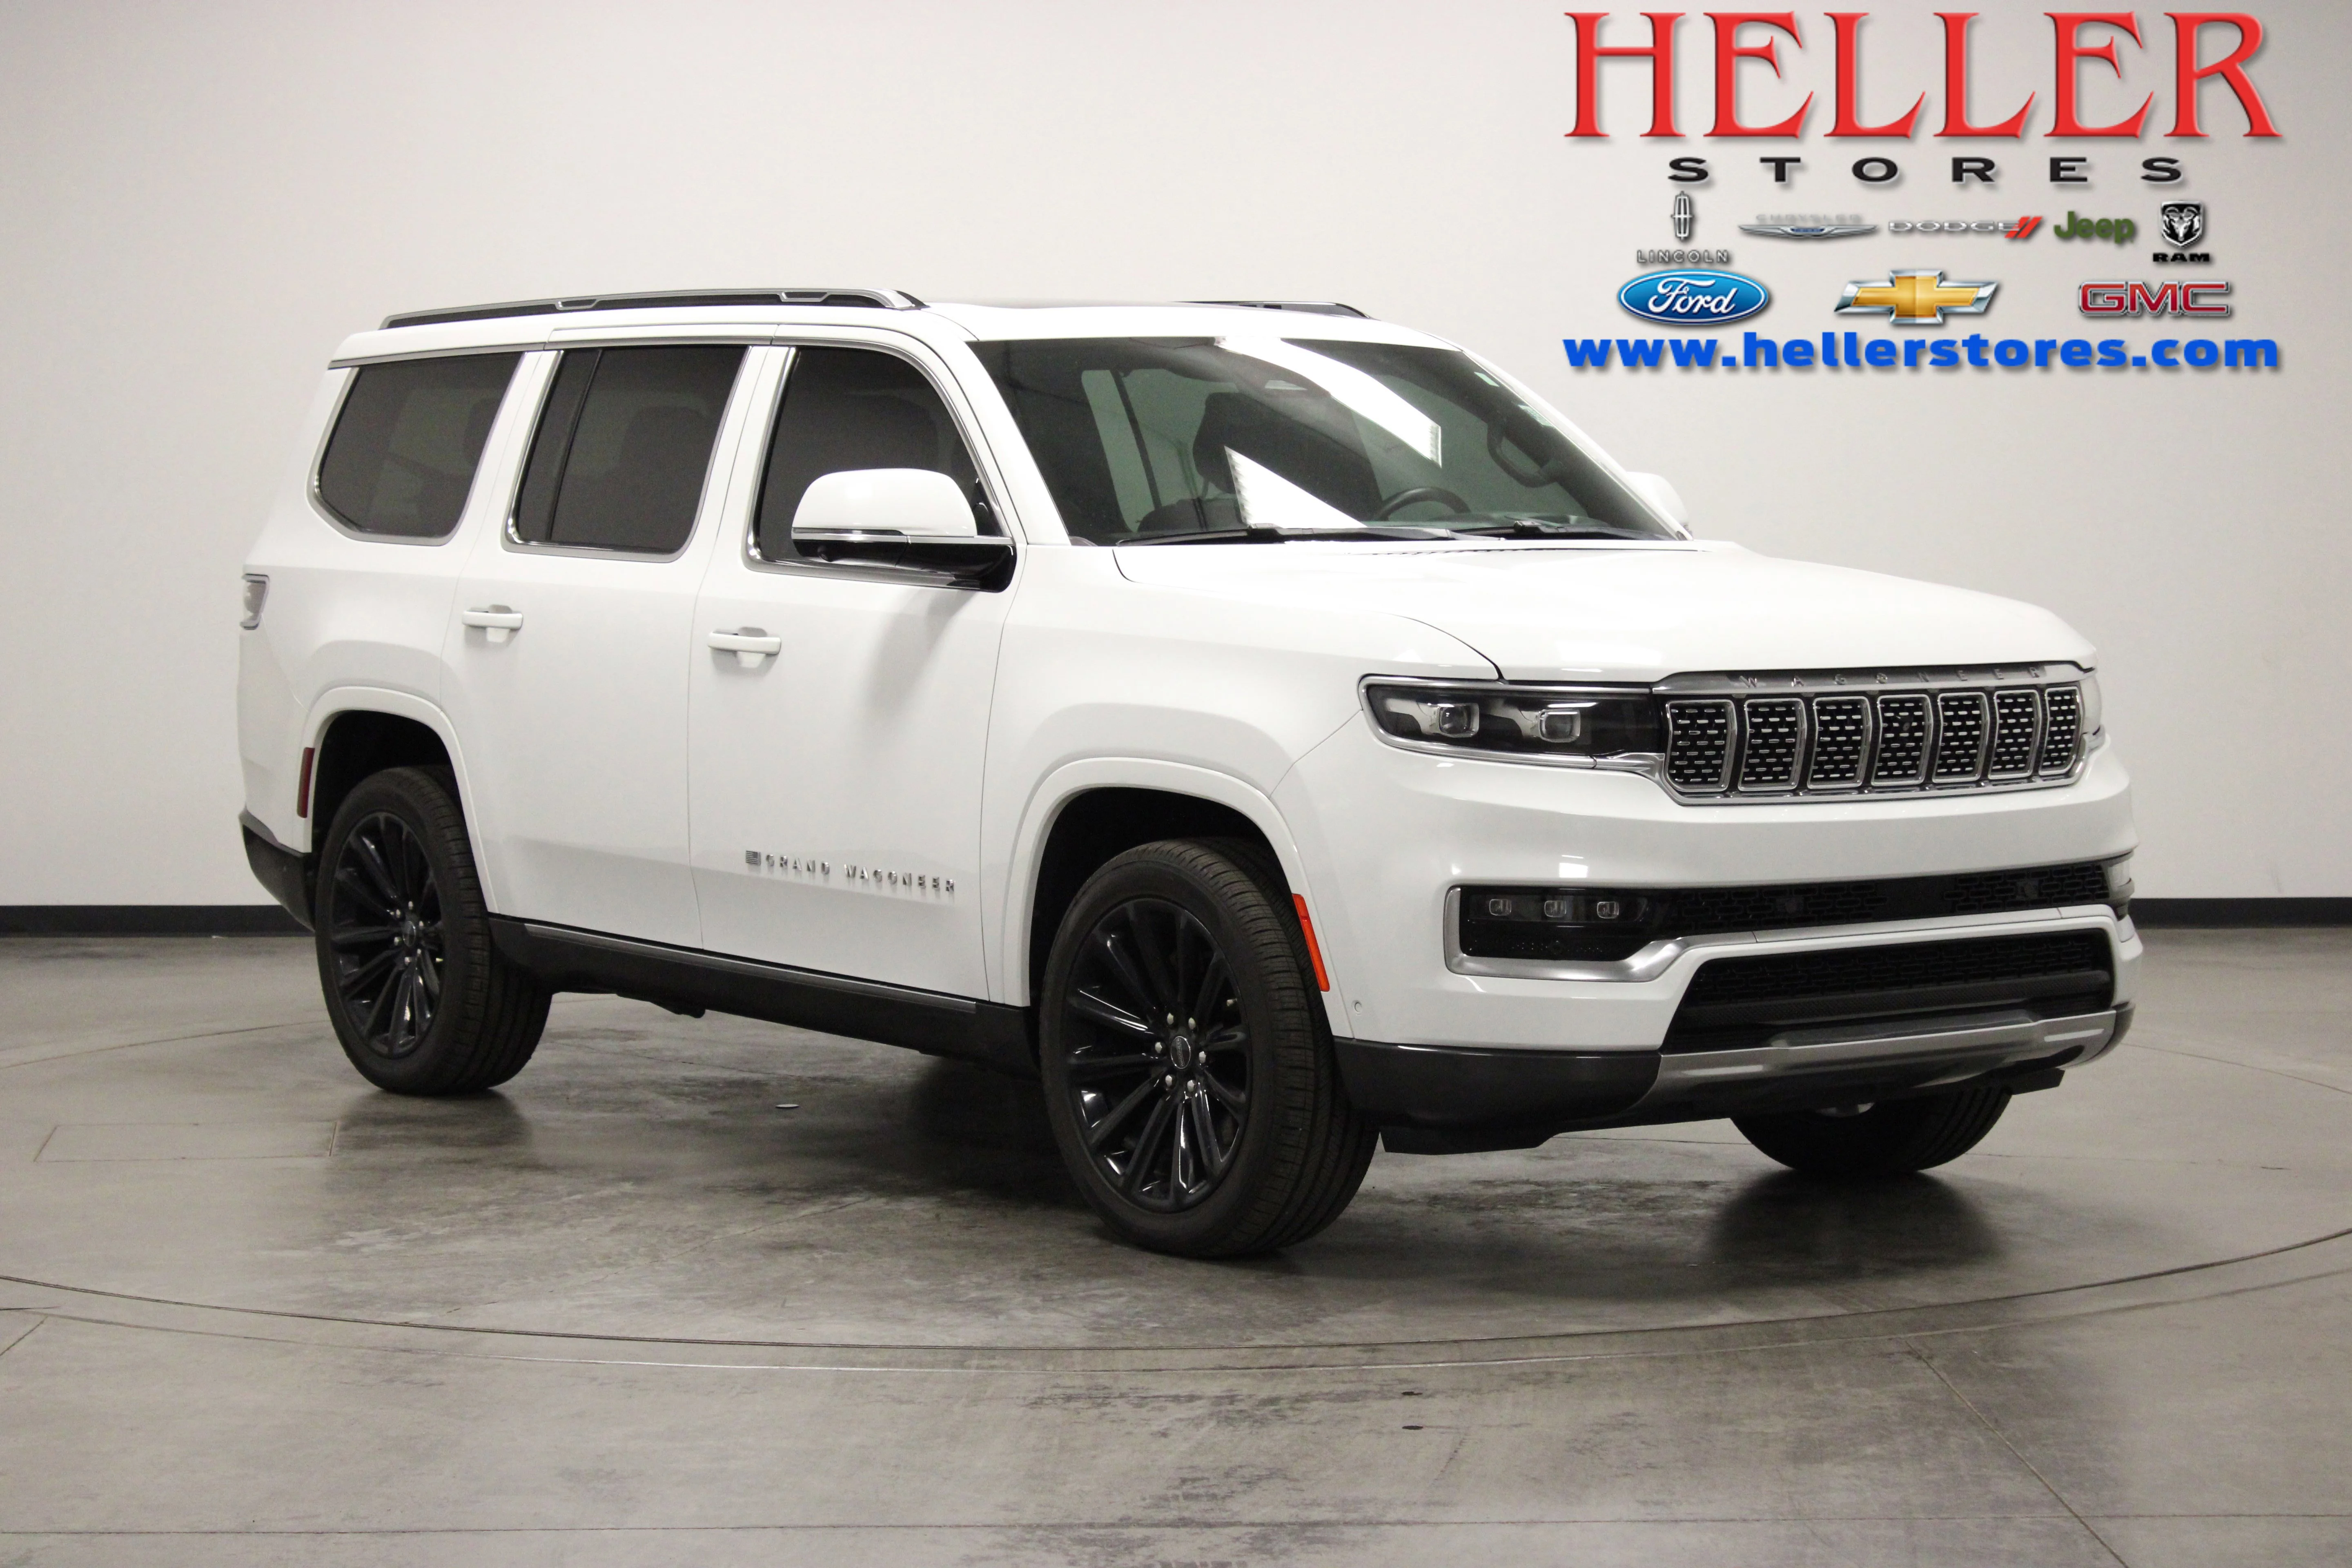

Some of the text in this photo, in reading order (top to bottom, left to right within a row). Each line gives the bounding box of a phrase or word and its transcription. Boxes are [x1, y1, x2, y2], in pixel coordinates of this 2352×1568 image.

[1739, 666, 2041, 688] WAGONEER
[765, 853, 955, 892] GRAND WAGONEER
